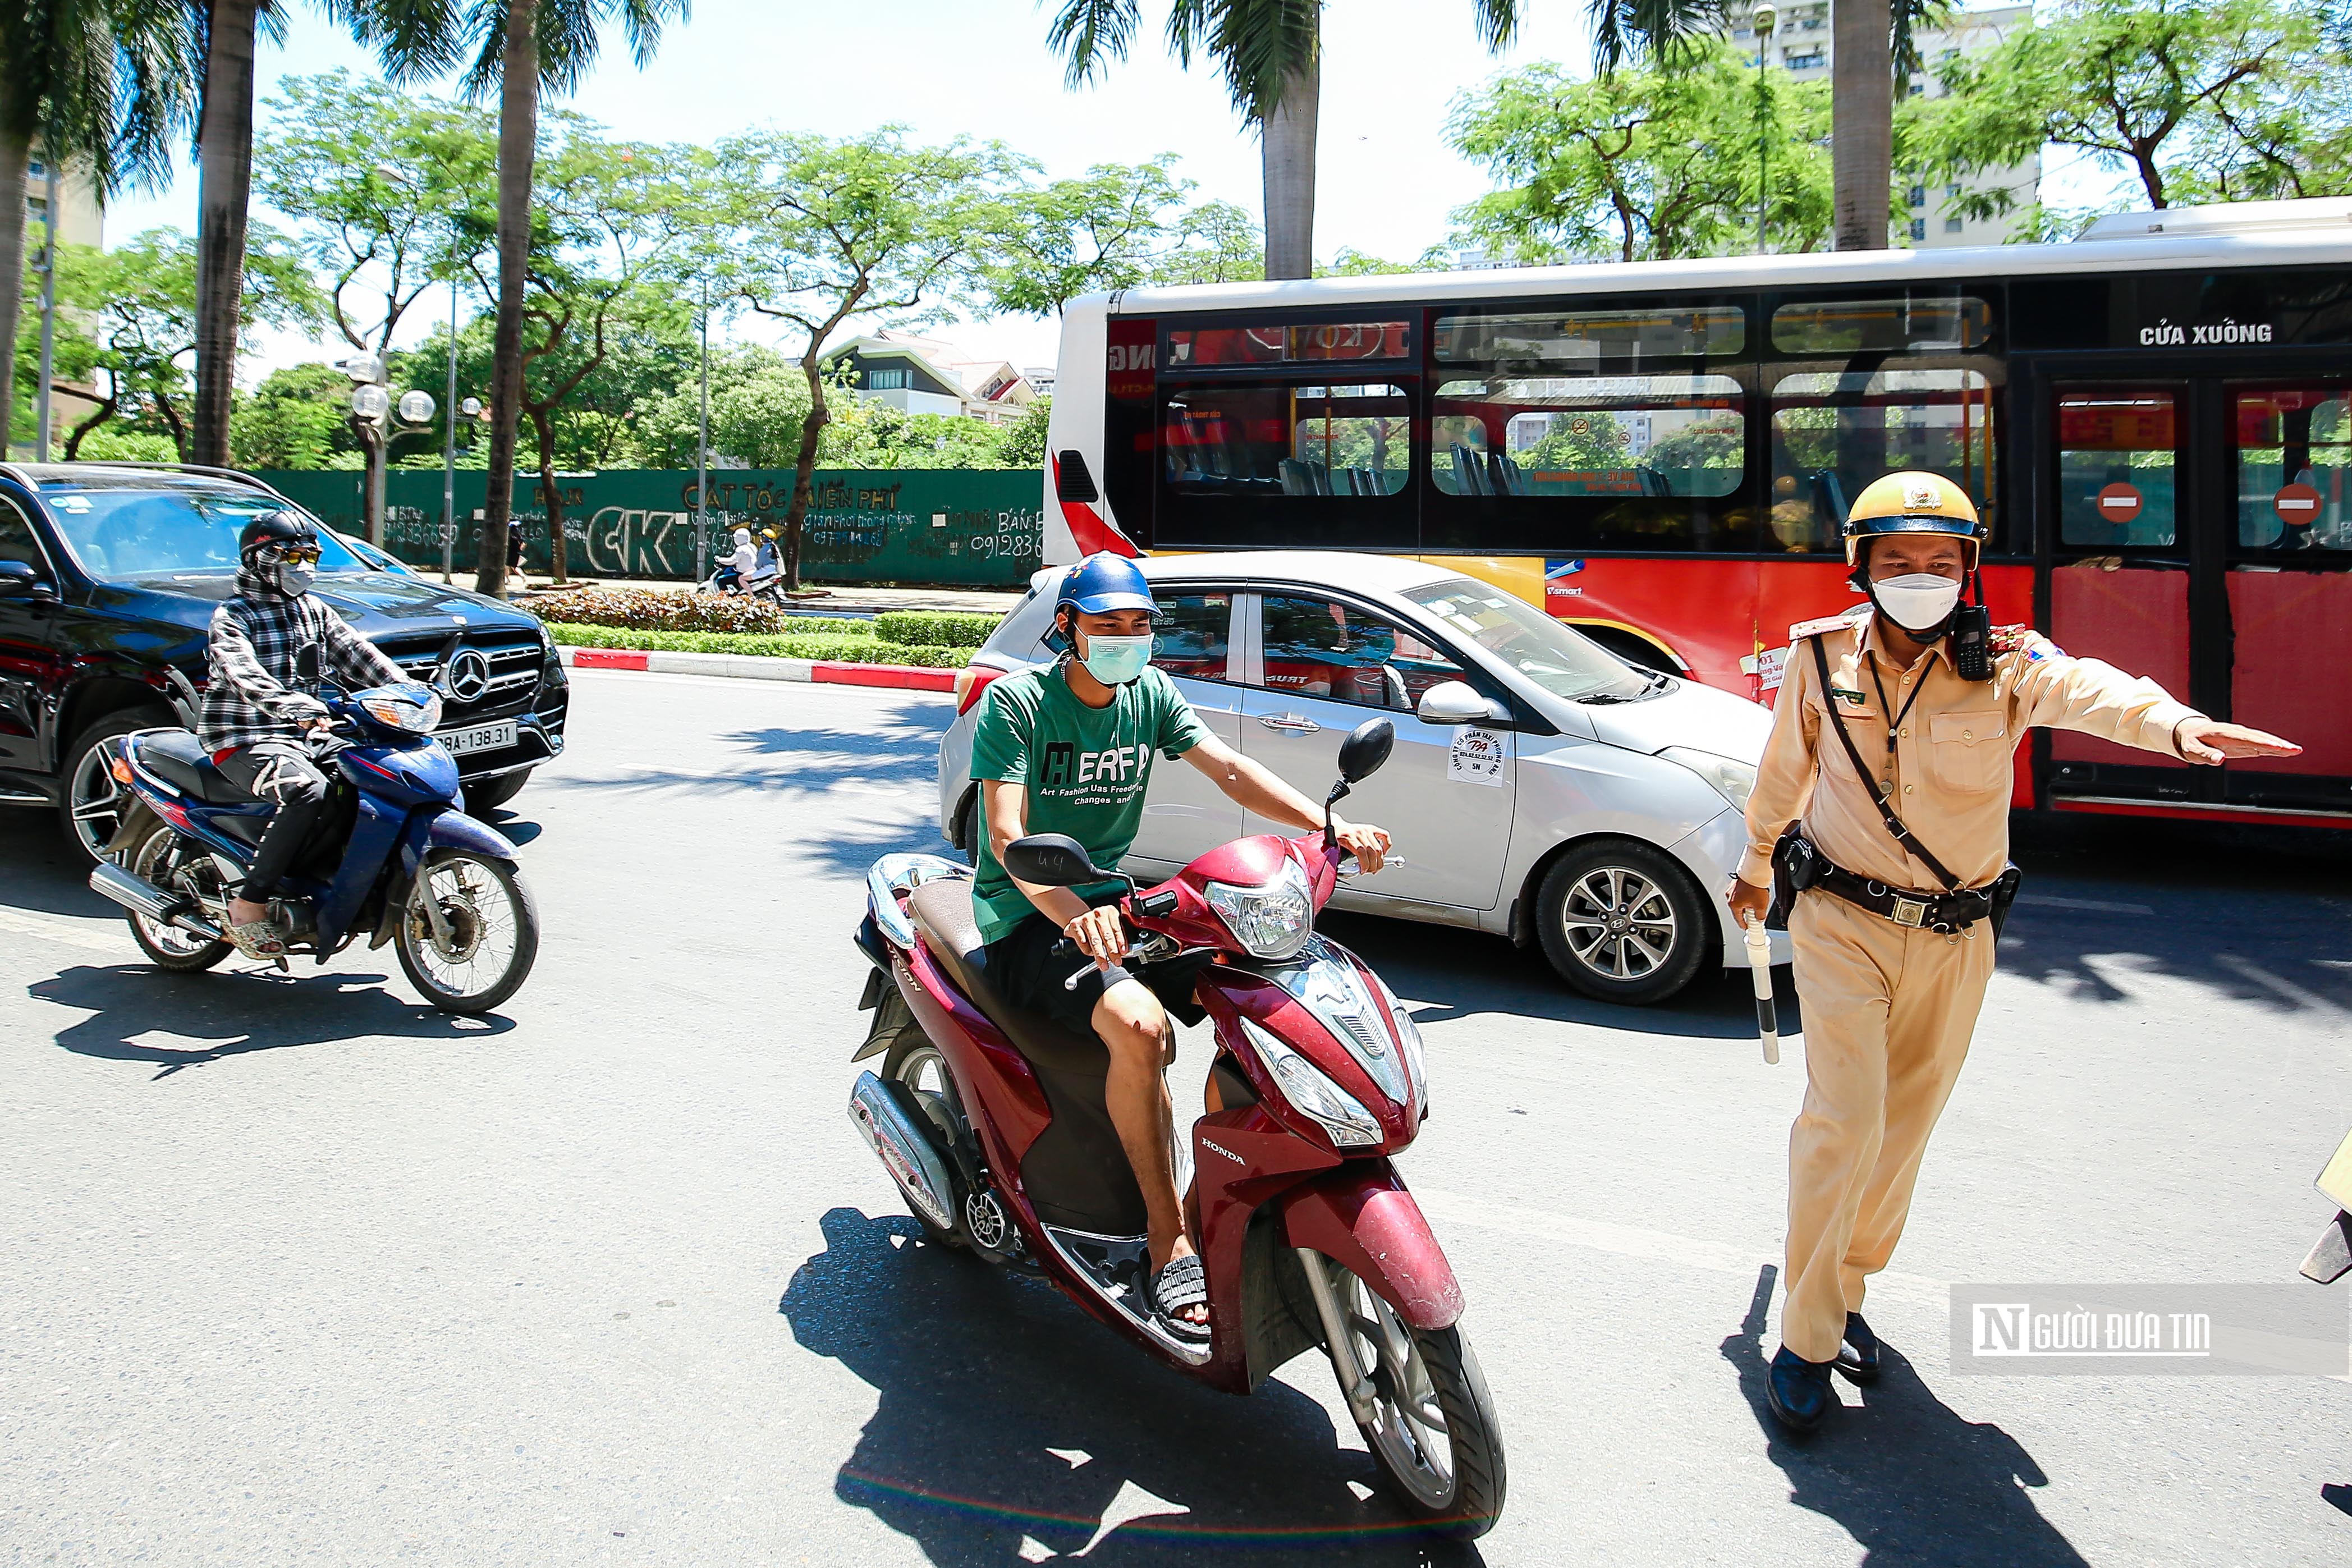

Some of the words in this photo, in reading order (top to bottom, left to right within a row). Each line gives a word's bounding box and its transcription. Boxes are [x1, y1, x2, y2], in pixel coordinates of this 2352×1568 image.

[2139, 318, 2185, 346] CỬA
[2191, 317, 2272, 345] XUỐNG
[1040, 787, 1056, 796] Art
[1059, 786, 1089, 796] Fashion
[1074, 796, 1111, 805] Changes
[1201, 1137, 1246, 1166] HONDA
